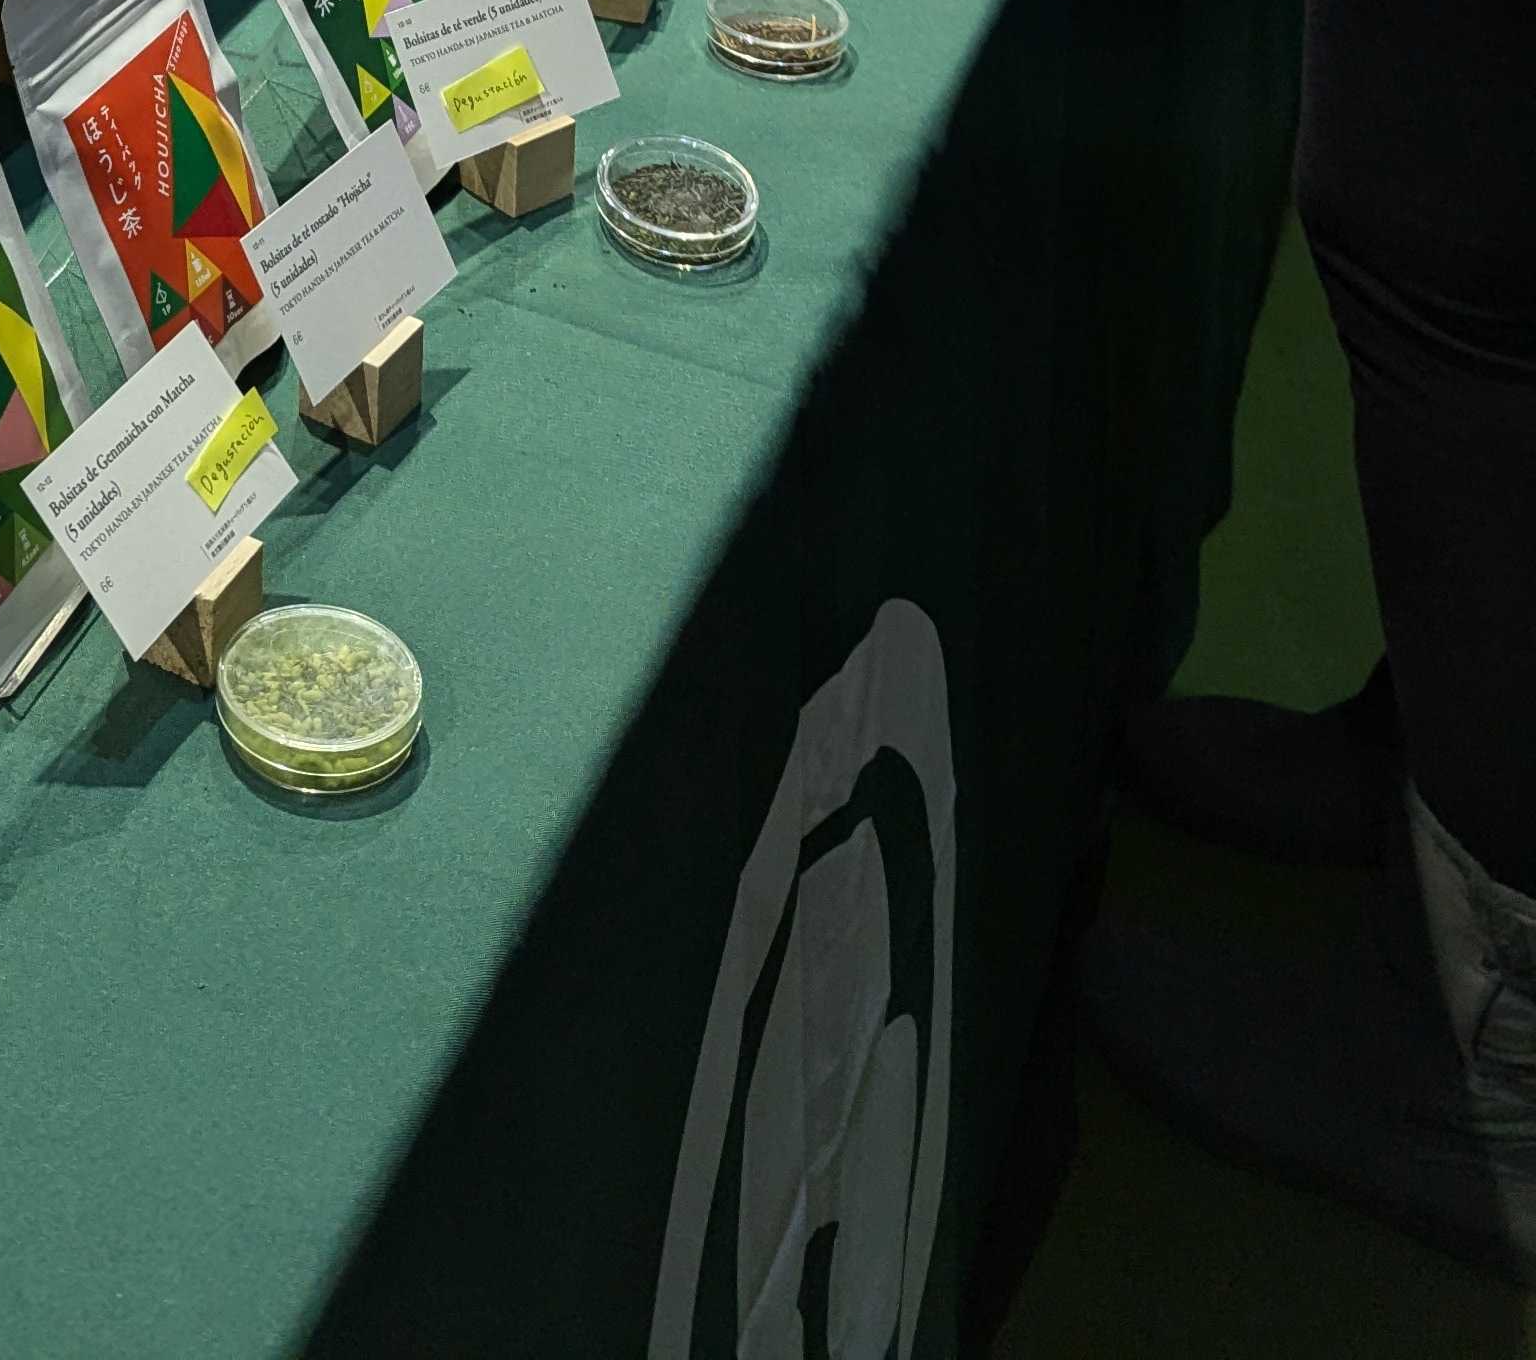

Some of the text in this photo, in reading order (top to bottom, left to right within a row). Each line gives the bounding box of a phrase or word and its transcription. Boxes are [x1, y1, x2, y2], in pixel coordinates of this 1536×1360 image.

[173, 46, 182, 63] tea
[177, 19, 189, 46] bags
[402, 30, 439, 49] Bolsitas
[440, 22, 452, 35] de
[452, 18, 462, 31] té
[462, 10, 487, 26] verde
[487, 5, 497, 20] (5
[452, 70, 527, 112] Degustación
[100, 104, 142, 191] ティーバッグ
[152, 73, 171, 198] HOUJICHA
[83, 116, 143, 239] ほうじ茶
[260, 172, 371, 273] Bolsitas de té tostado "Hojicha"
[270, 249, 318, 298] (5 unidades)
[48, 374, 195, 517] Bolsitas de Genmaicha con Matcha
[198, 411, 266, 495] Degustación
[64, 480, 121, 542] (5 unidades)
[79, 532, 106, 561] TOKYO
[140, 462, 174, 501] JAPANESE
[171, 450, 189, 466] TEA
[191, 415, 222, 448] MATCHA
[99, 575, 113, 592] 6€
